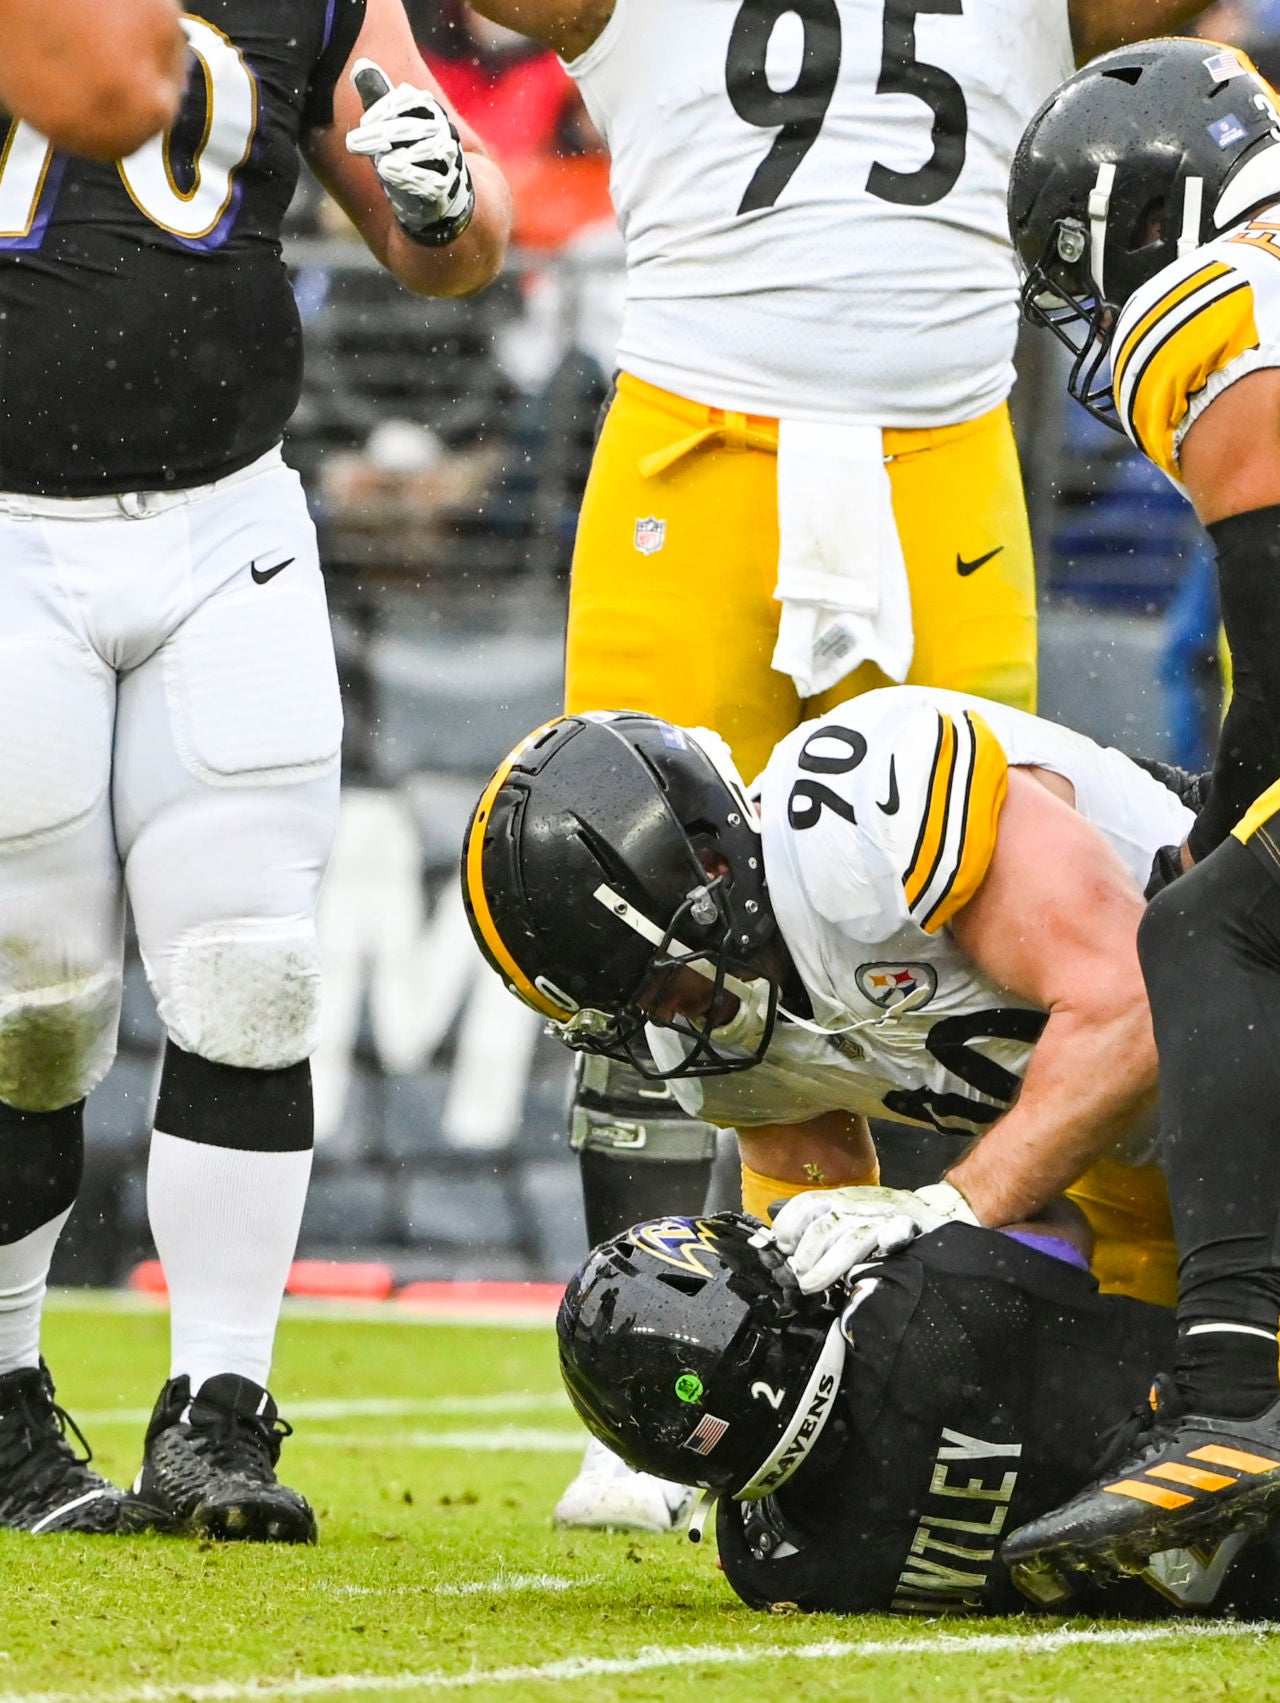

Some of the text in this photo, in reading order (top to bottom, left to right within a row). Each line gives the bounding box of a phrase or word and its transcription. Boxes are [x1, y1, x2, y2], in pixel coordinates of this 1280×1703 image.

[726, 0, 968, 216] 95
[787, 725, 868, 830] 90
[750, 1381, 786, 1410] 2
[757, 1373, 835, 1487] RAVENS
